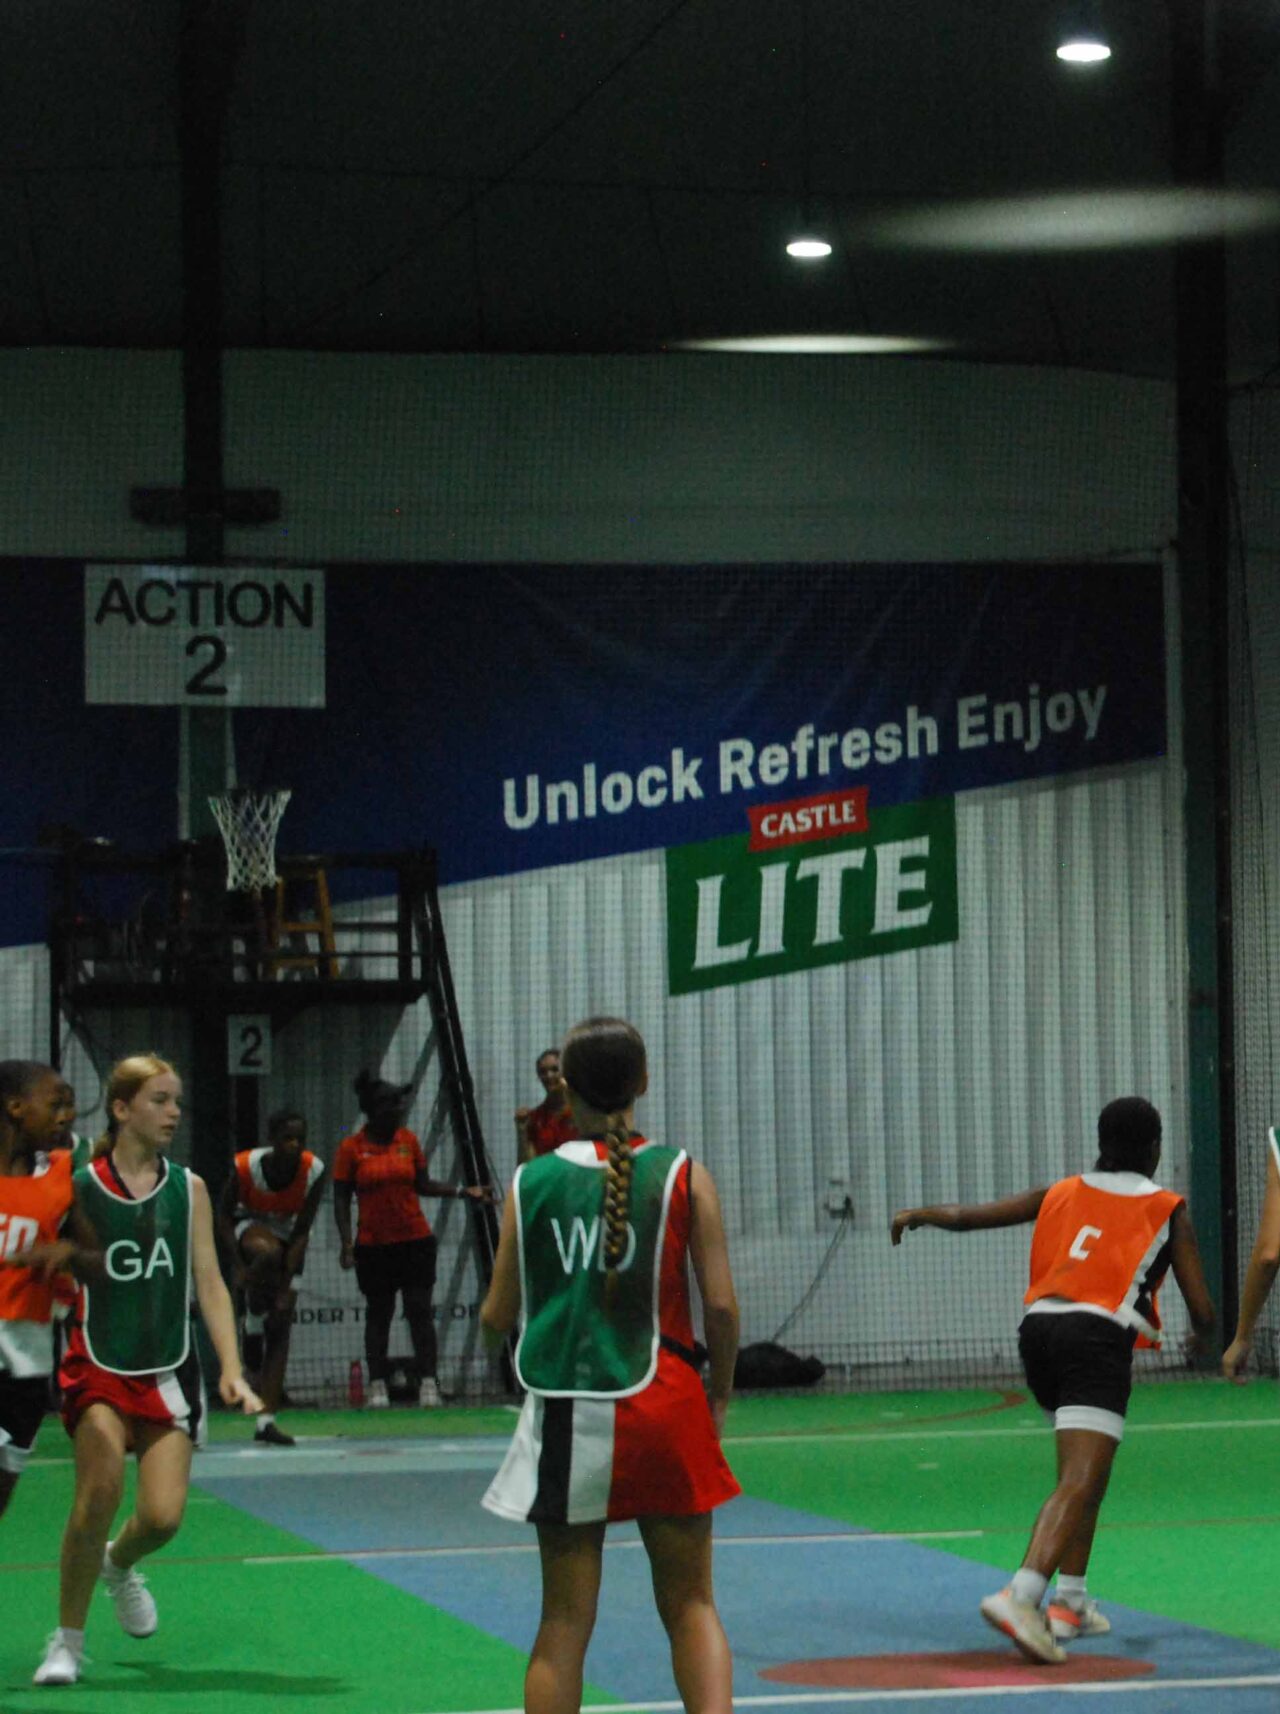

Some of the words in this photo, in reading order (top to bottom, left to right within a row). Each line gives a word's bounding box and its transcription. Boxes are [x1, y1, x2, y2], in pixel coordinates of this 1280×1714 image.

[95, 577, 314, 630] ACTION
[184, 635, 228, 696] 2
[502, 747, 704, 831] Unlock
[718, 705, 939, 794] Refresh
[956, 683, 1107, 752] Enjoy
[759, 799, 857, 839] CASTLE
[691, 834, 934, 971] LITE
[238, 1025, 264, 1067] 2
[104, 1236, 176, 1282] GA
[549, 1212, 638, 1275] WD
[1068, 1224, 1103, 1261] C
